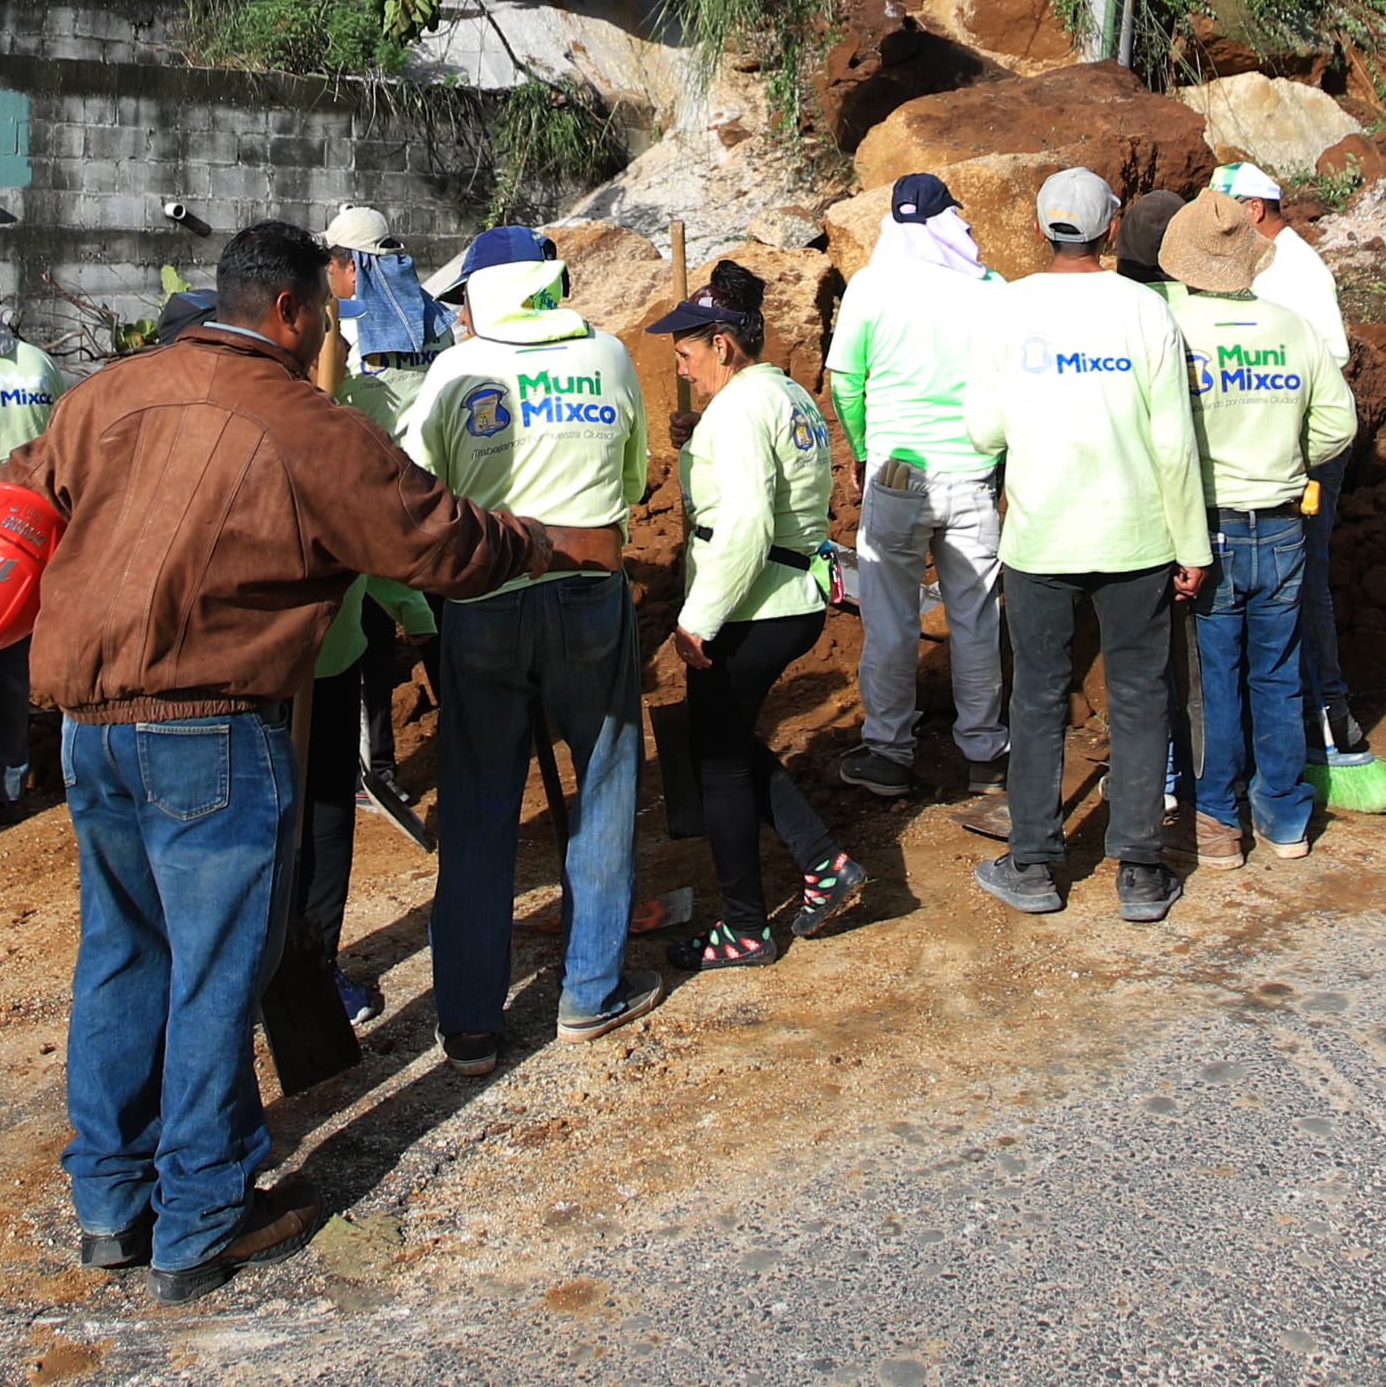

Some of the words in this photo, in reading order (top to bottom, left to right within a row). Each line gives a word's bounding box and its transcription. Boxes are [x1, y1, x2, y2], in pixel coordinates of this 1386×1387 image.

[1056, 352, 1132, 374] Mixco
[1217, 344, 1286, 368] Muni
[517, 370, 601, 400] Muni
[1221, 368, 1301, 393] Mixco
[521, 396, 616, 427] Mixco
